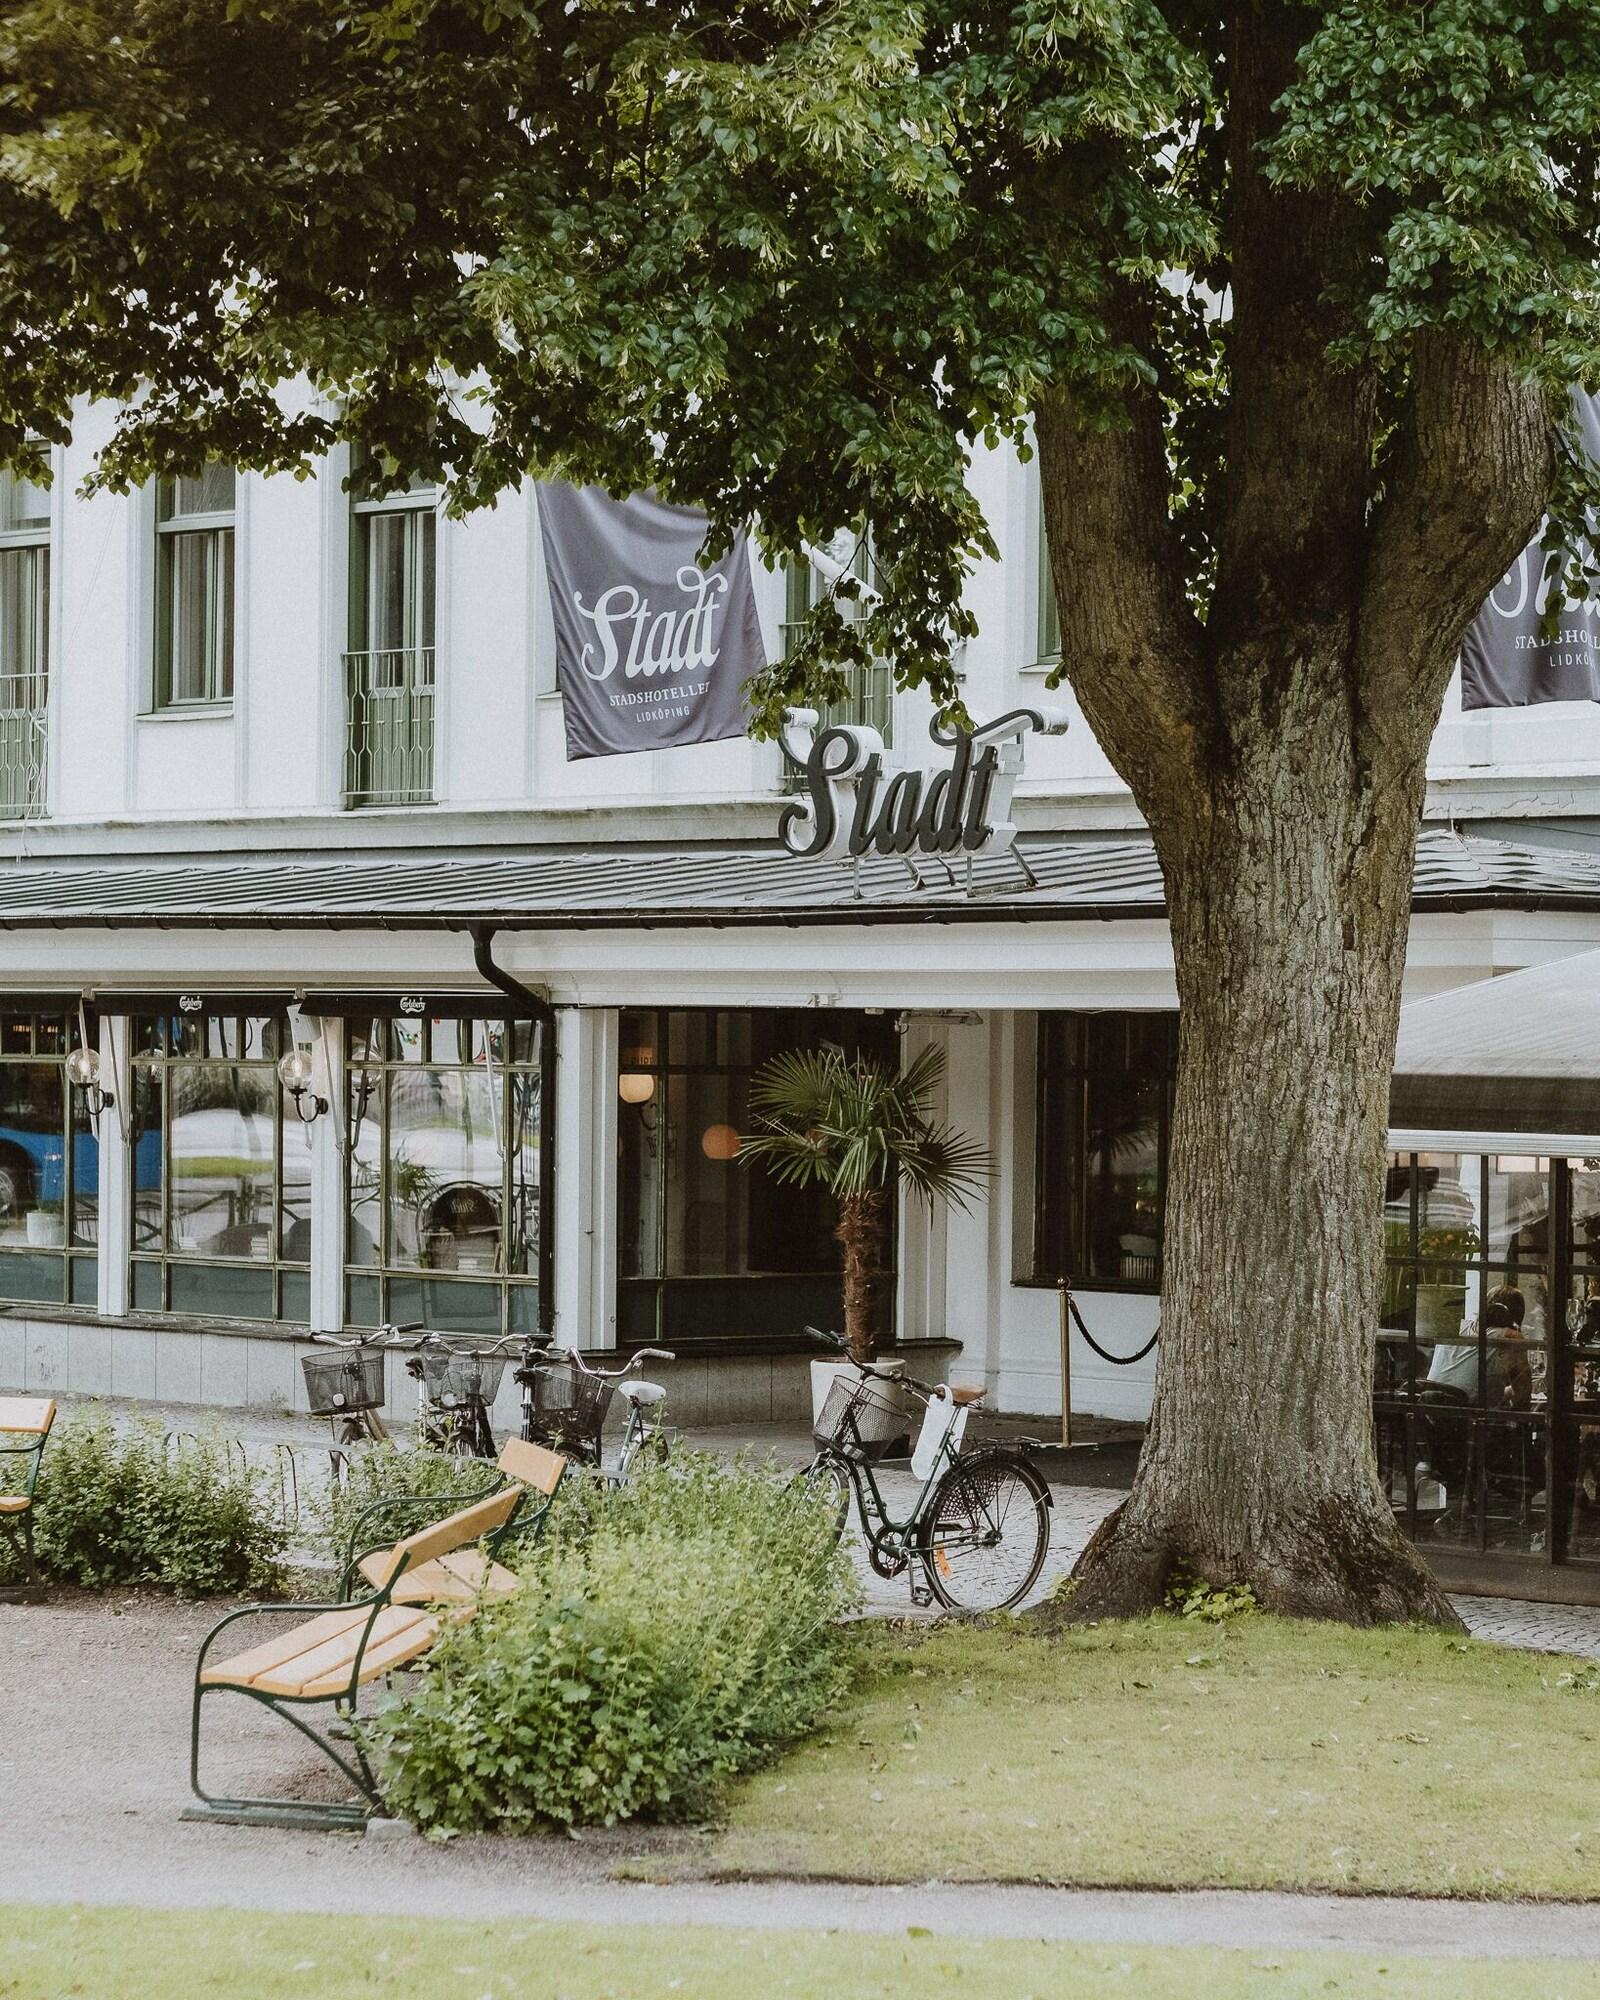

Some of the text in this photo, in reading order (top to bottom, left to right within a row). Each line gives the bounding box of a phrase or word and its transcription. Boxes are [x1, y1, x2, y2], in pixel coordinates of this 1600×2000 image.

[573, 565, 729, 681] Stadt
[609, 681, 710, 707] STADSHOTELLET
[636, 705, 690, 723] LIDKÖPING
[778, 707, 1048, 859] Stadt
